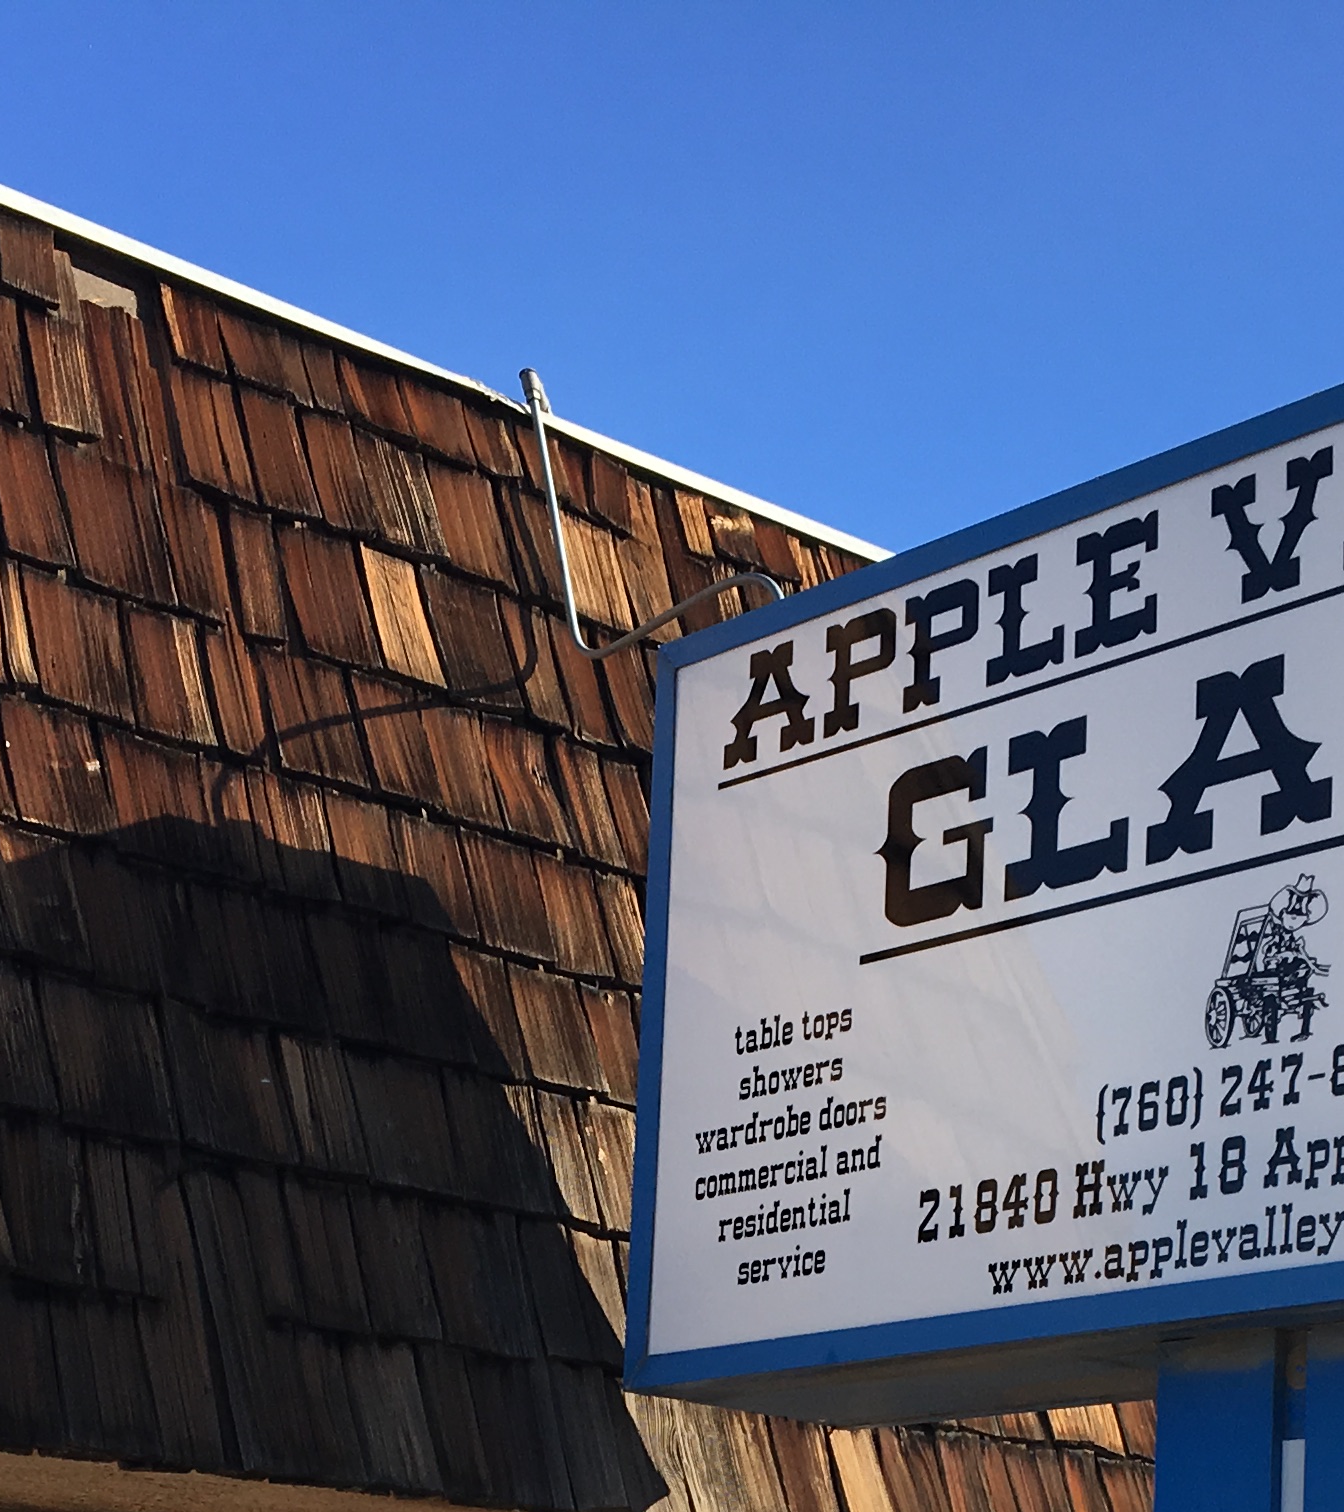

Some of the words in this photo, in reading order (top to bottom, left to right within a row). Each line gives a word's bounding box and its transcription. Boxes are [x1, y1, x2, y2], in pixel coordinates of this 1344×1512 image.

[723, 510, 1158, 770] APPLE
[735, 1015, 793, 1055] table
[802, 1009, 852, 1040] tops
[739, 1058, 842, 1100] showers
[1096, 1067, 1203, 1145] (760)
[694, 1105, 810, 1154] wardrobe
[819, 1096, 886, 1131] doors
[694, 1145, 827, 1200] commercial
[837, 1135, 882, 1175] and
[918, 1169, 1059, 1243] 21840
[1073, 1160, 1168, 1219] Hwy
[1190, 1136, 1247, 1200] 18
[718, 1188, 850, 1242] residential
[738, 1245, 825, 1285] service
